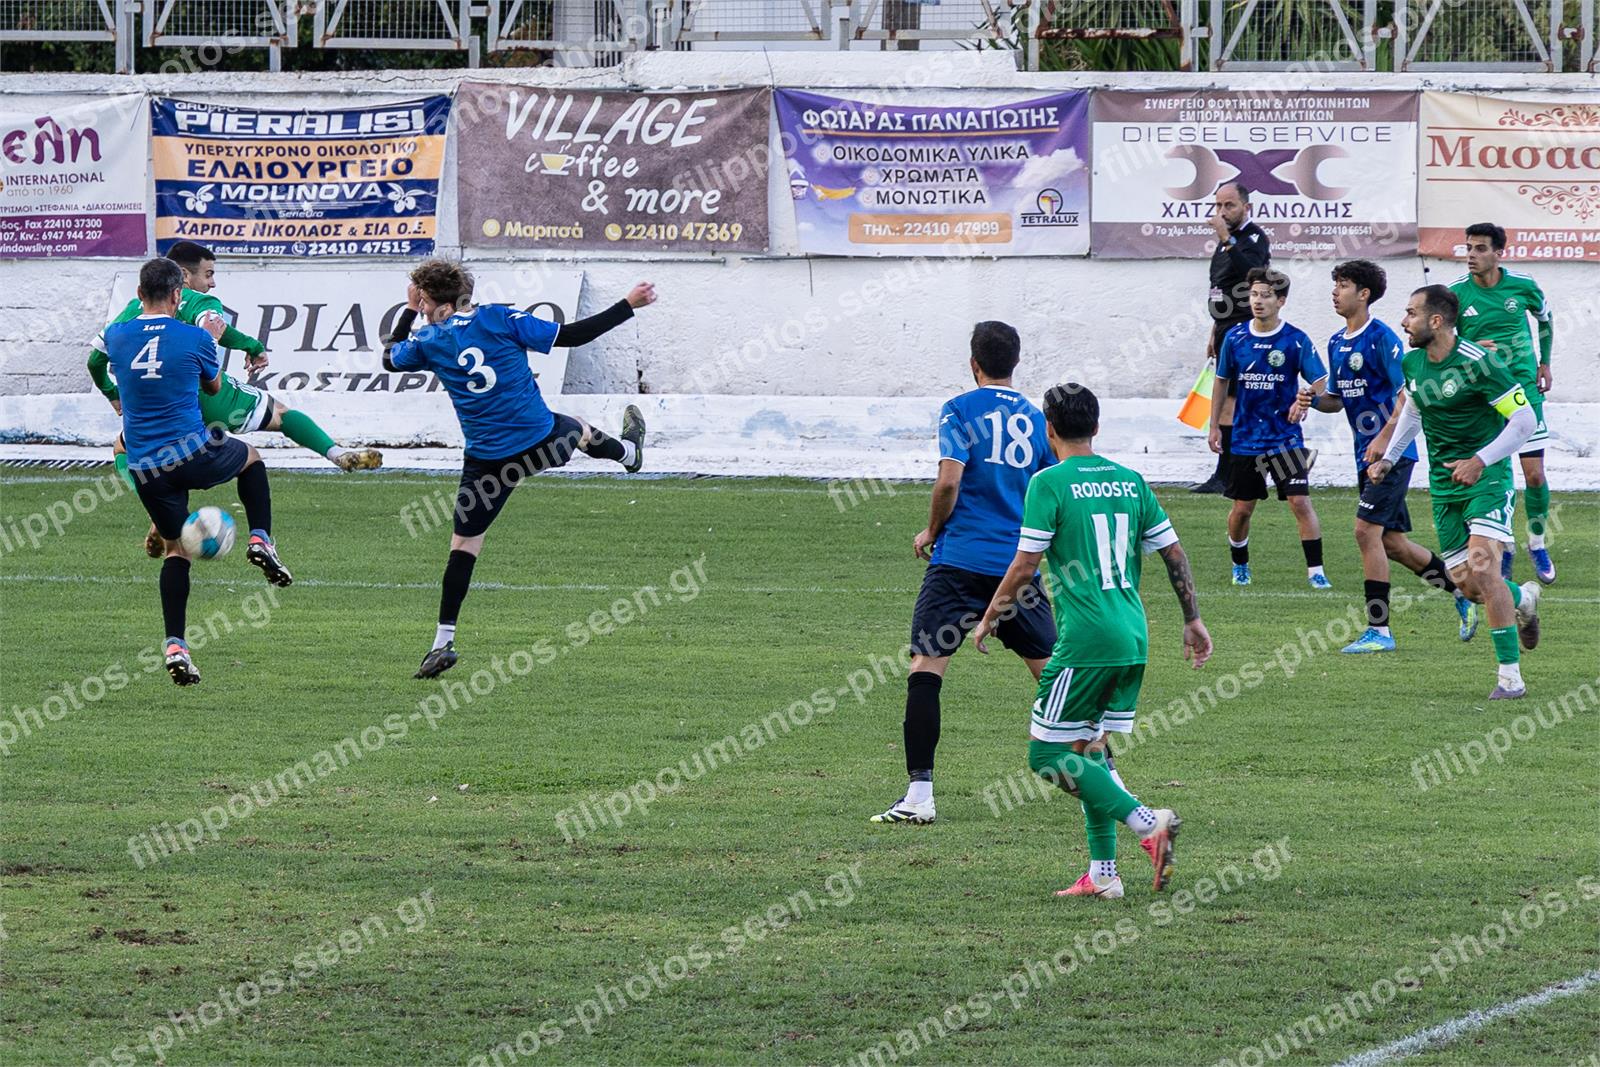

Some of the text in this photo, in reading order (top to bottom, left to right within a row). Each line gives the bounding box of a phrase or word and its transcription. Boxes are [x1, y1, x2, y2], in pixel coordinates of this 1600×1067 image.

[175, 101, 238, 113] GRUPPO
[1144, 97, 1370, 110] ΣΥΝΕΡΓΕΙΟ ΦΟΡΤΗΓΩΝ & ΑΥΤΟΚΙΝΗΤΩΝ
[175, 108, 425, 135] PIERALISI
[507, 90, 717, 147] VILLAGE
[803, 107, 1060, 131] ΦΩΤΑΡΑΣ ΠΑΝΑΓΙΩΤΗΣ
[1179, 110, 1334, 121] ΕΜΠΟΡΙΑ ΑΝΤΑΛΛΑΚΤΙΚΩΝ
[1122, 126, 1392, 142] DIESEL SERVICE
[185, 141, 417, 157] ΥΠΕΡΣΥΓΧΡΟΝΟ ΟΙΚΟΛΟΓΙΚΟ
[833, 145, 1030, 164] ΟΙΚΟΔΟΜΙΚΑ ΥΛΙΚΑ
[188, 157, 414, 179] ΕΛΑΙΟΥΡΓΕΙΟ
[882, 168, 980, 183] ΧΡΩΜΑΤΑ
[6, 172, 105, 186] INTERNATIONAL
[7, 185, 74, 197] από το 1960
[221, 182, 384, 200] MOLINOVA
[581, 180, 721, 215] & more
[876, 189, 987, 205] ΜΟΝΩΤΙΚΑ
[1162, 202, 1353, 218] ΧΑΤΖΑΝΩΛΗΣ
[25, 220, 41, 229] Fax
[44, 219, 72, 229] 22410
[74, 218, 102, 228] 37300
[1021, 215, 1080, 225] TETRALUX
[42, 231, 63, 241] 6947
[67, 231, 83, 240] 944
[86, 231, 102, 240] 207
[176, 221, 426, 238] ΧΑΡΠΟΣ ΝΙΚΟΛΑΟΣ & ΣΙΑ Ο.Ε.
[504, 221, 583, 240] Μαριτσά
[625, 222, 742, 242] 22410 47369
[863, 222, 1000, 236] ΤΗΛ.: 22410 47999
[1304, 226, 1321, 235] +30
[1322, 226, 1348, 235] 22410
[1517, 232, 1578, 242] ΠΛΑΤΕΙΑ
[233, 244, 249, 253] από
[262, 245, 286, 254] 1927
[308, 241, 411, 255] 22410 47515
[1532, 246, 1584, 258] 48109
[131, 336, 163, 379] 4
[458, 347, 497, 394] 3
[1267, 374, 1285, 382] GAS
[1245, 382, 1275, 390] SYSTEM
[1514, 393, 1526, 406] C
[984, 411, 1034, 468] 18
[1070, 482, 1138, 499] RODOS FC
[1091, 513, 1131, 590] 11
